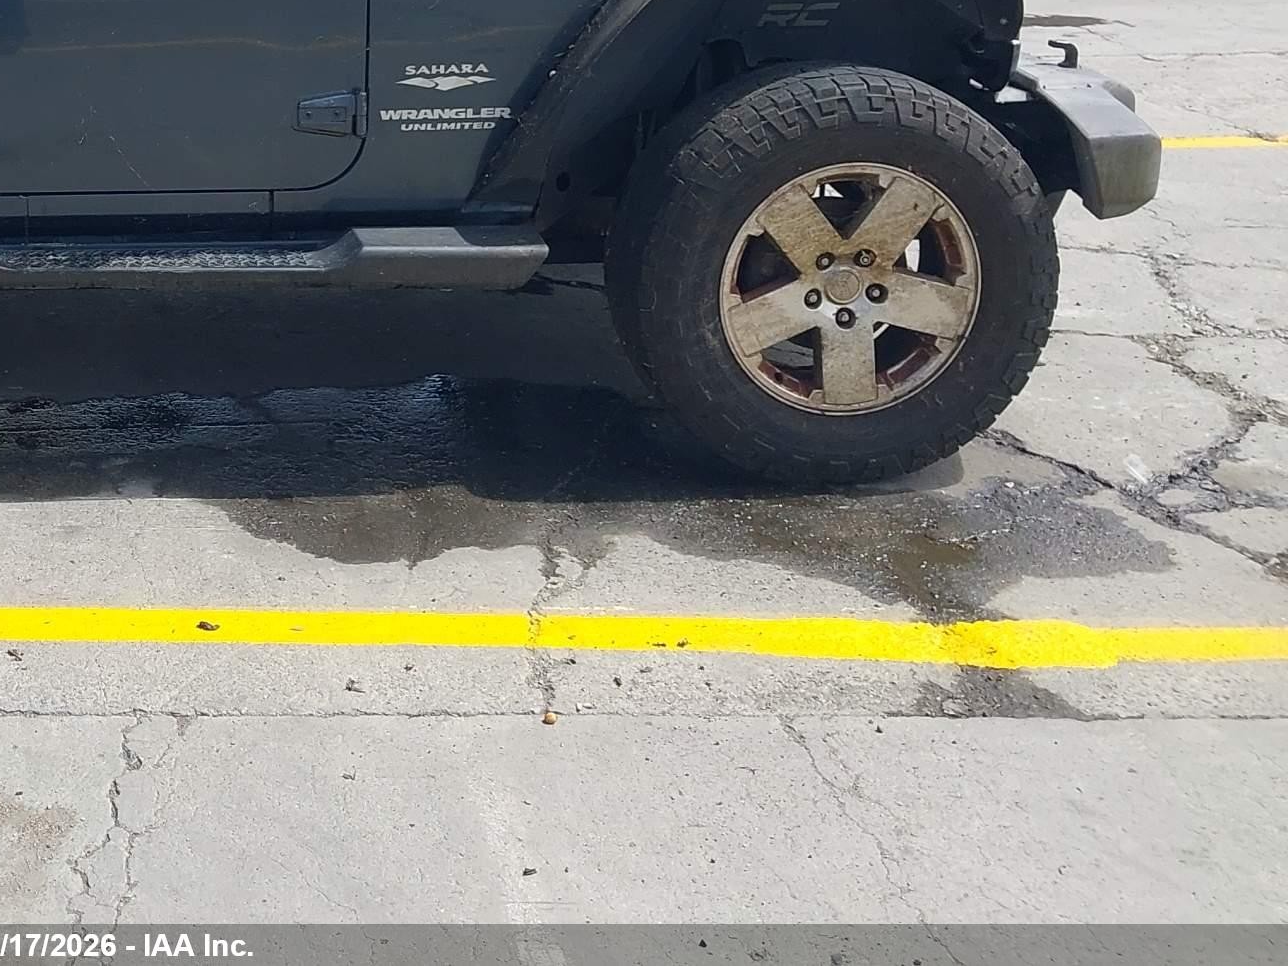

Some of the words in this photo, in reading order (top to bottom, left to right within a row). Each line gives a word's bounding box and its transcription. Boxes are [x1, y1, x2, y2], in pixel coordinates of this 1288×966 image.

[756, 1, 842, 27] RC
[404, 63, 489, 75] SAHARA
[379, 107, 511, 121] WRANGLER
[400, 121, 496, 132] UNLIMITED
